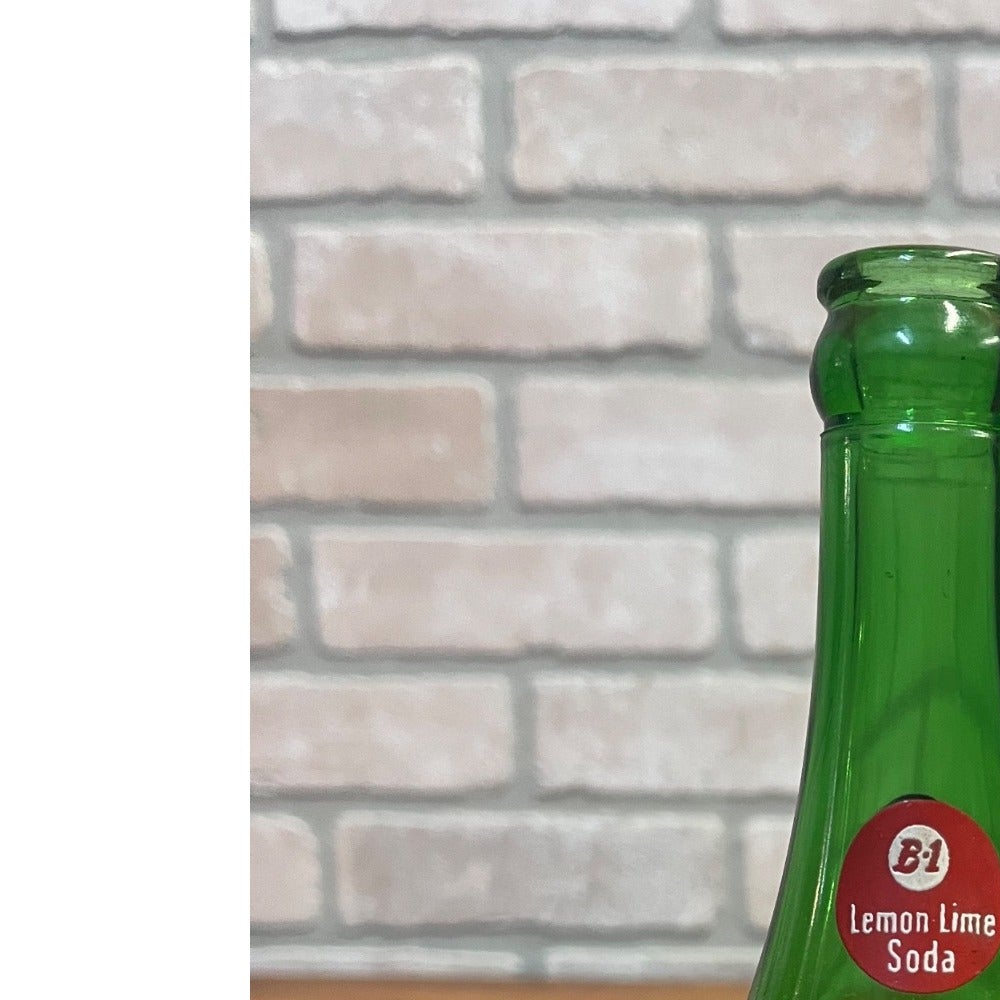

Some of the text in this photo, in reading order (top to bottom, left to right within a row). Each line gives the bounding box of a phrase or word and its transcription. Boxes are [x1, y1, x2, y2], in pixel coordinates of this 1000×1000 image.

[850, 901, 997, 938] Lemon Lime
[887, 938, 956, 974] Soda
